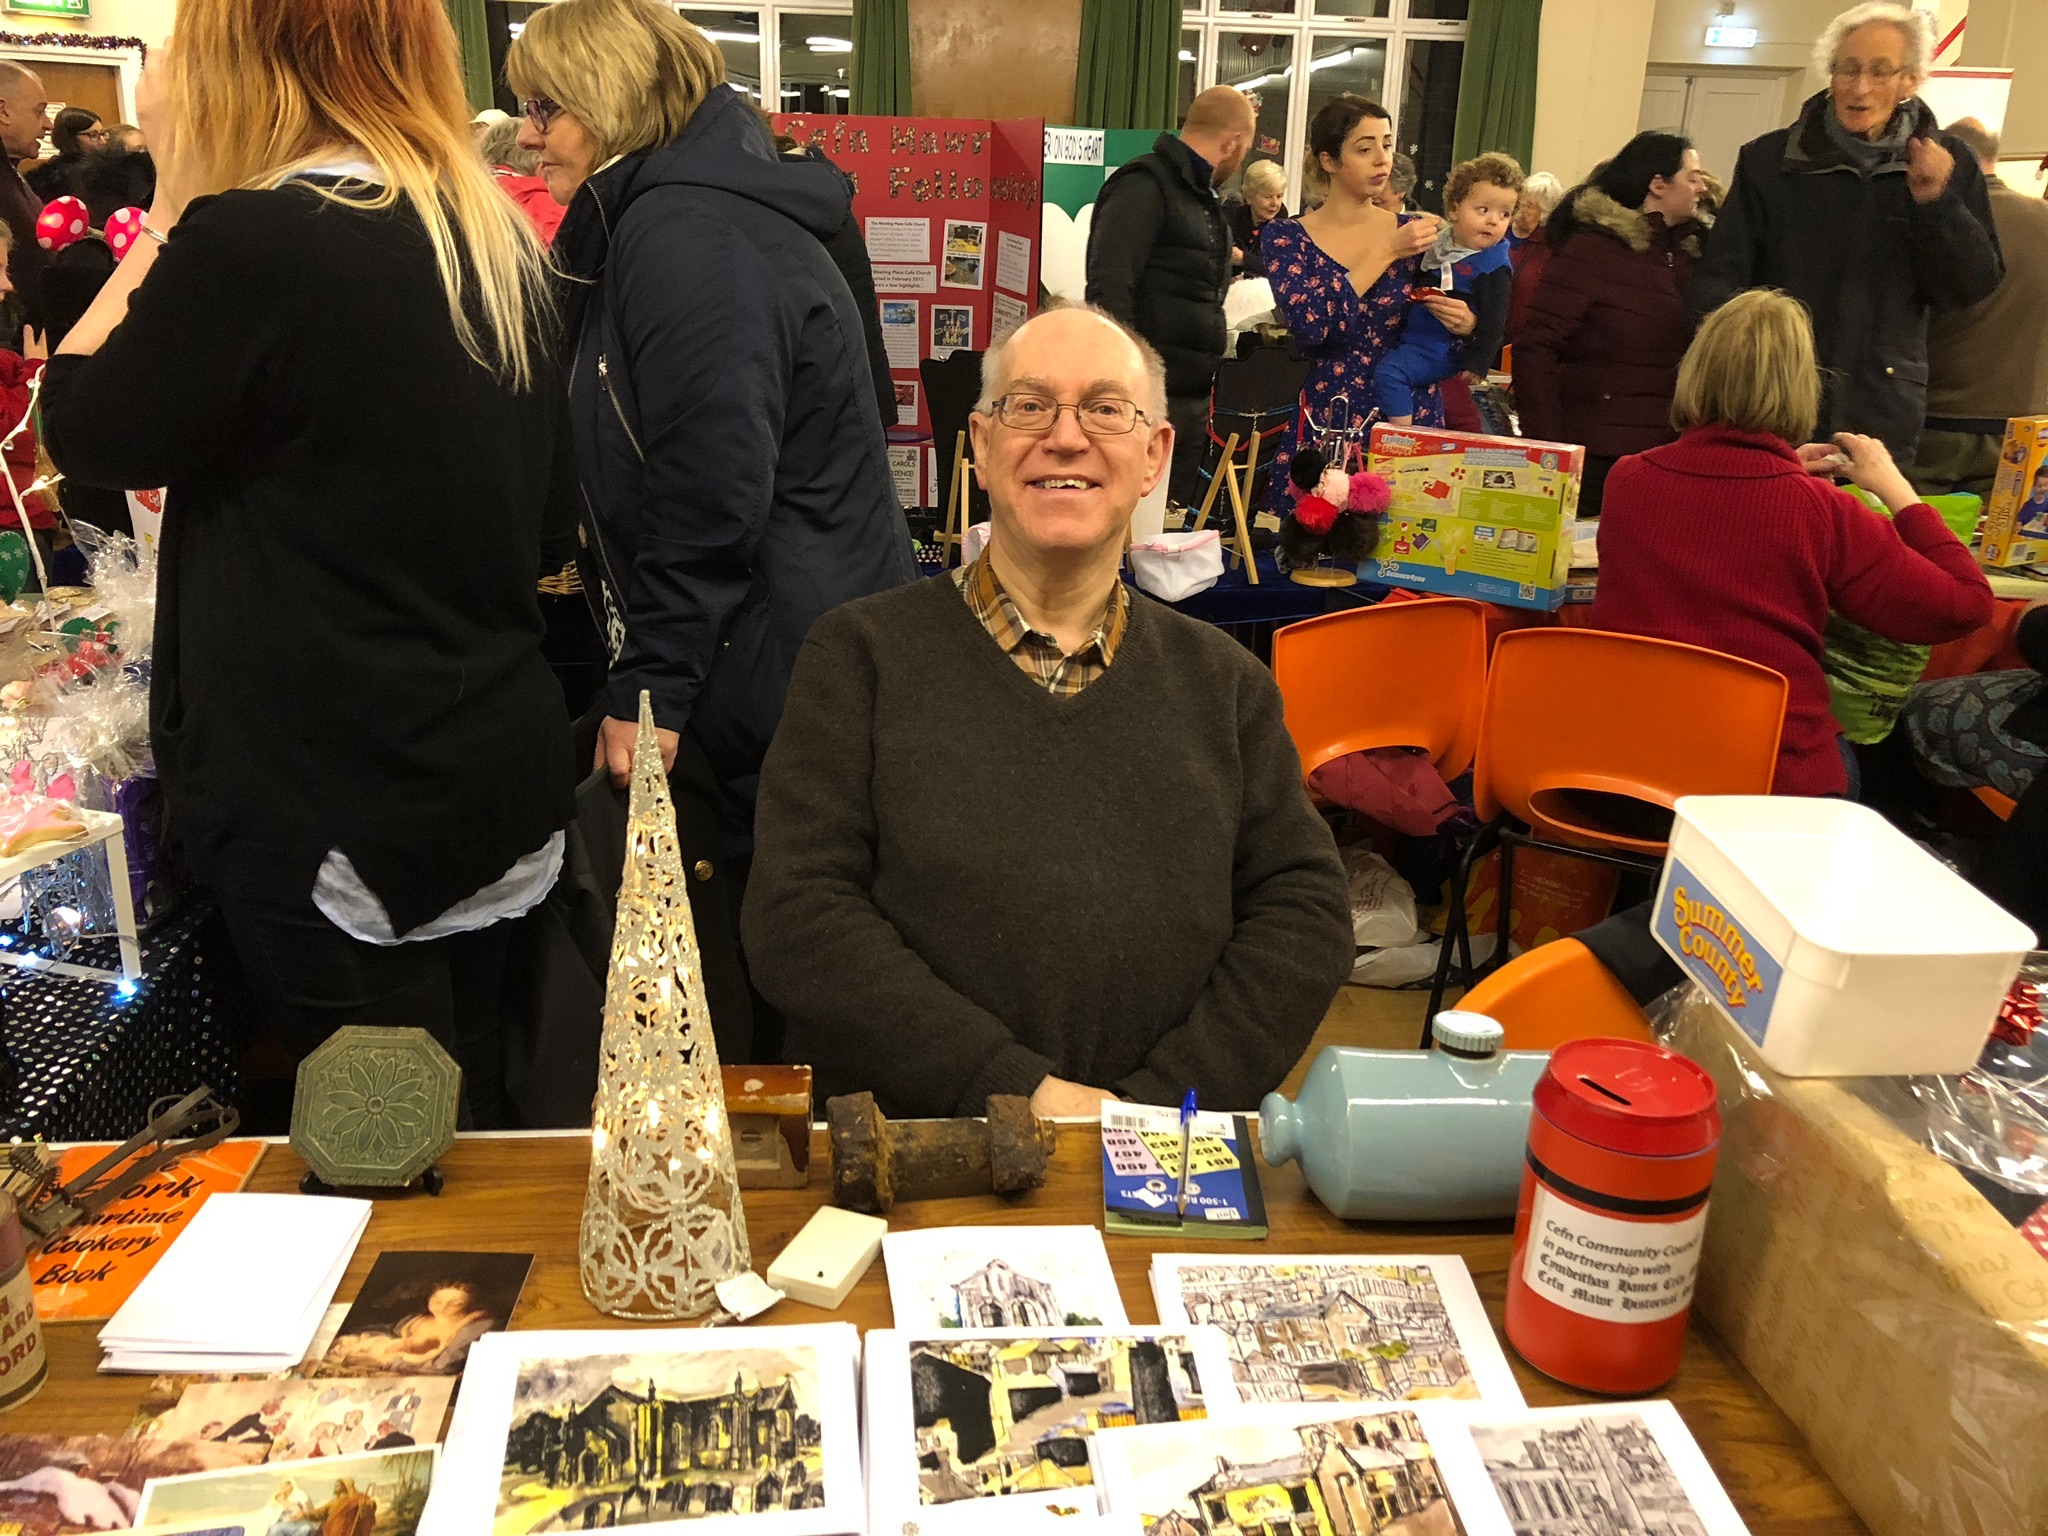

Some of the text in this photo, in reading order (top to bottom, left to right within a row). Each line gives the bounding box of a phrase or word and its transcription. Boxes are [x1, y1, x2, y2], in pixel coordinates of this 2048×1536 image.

[890, 124, 991, 155] Mawr
[892, 460, 916, 468] CAROLS
[1673, 885, 1764, 994] Summer
[1678, 925, 1747, 1008] County
[105, 1175, 205, 1201] ork
[1199, 1196, 1229, 1206] 1-500
[41, 1232, 163, 1257] Cookery
[1546, 1219, 1575, 1242] Cefn
[1576, 1234, 1661, 1260] Community
[1542, 1235, 1555, 1251] in
[1555, 1246, 1641, 1276] partnership
[1641, 1262, 1671, 1276] with
[34, 1261, 117, 1286] Book
[1537, 1270, 1565, 1292] Cefn
